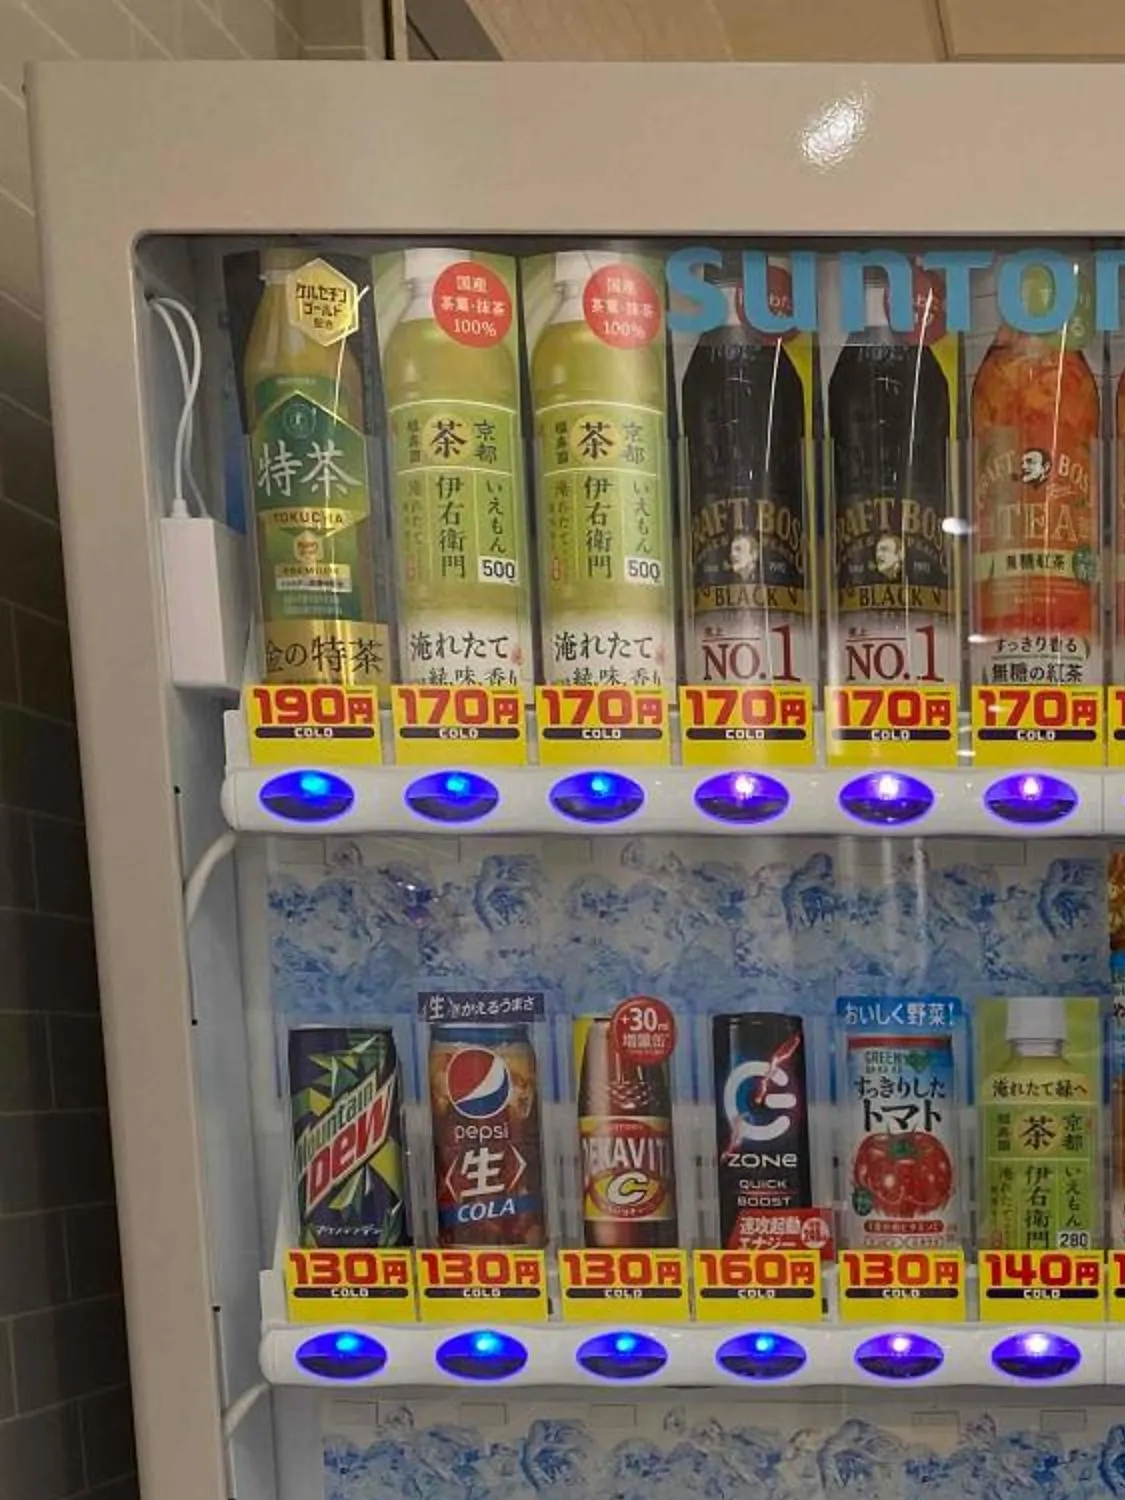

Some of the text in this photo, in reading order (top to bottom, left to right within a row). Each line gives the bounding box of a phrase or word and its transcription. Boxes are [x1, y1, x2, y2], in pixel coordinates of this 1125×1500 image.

[452, 316, 497, 338] 100%
[601, 320, 646, 340] 100%
[430, 420, 467, 459] 茶
[474, 420, 498, 463] 京都
[576, 421, 615, 460] 茶
[622, 421, 646, 463] 京都
[257, 439, 364, 497] 特茶
[435, 475, 466, 579] 伊右衛門
[485, 480, 507, 554] いえもん
[583, 475, 614, 580] 伊右衛門
[632, 481, 652, 554] いえもん
[997, 502, 1079, 542] TEA
[481, 560, 515, 582] 500
[627, 560, 660, 581] 500
[714, 587, 778, 607] BLACK
[859, 587, 922, 606] BLACK
[266, 635, 384, 674] 金の特茶
[410, 631, 510, 662] 淹れたて
[553, 631, 655, 662] 淹れたて
[702, 624, 801, 682] NO.1
[846, 624, 944, 682] NO.1
[996, 637, 1078, 654] すっきり香る
[991, 661, 1084, 682] 無糖の紅茶
[254, 688, 374, 725] 190円
[400, 688, 519, 725] 170円
[545, 688, 664, 725] 170円
[686, 690, 806, 727] 170円
[837, 690, 951, 727] 170円
[978, 690, 1097, 727] 170円
[294, 728, 333, 739] COLD
[439, 728, 479, 739] COLD
[582, 728, 621, 740] COLD
[725, 729, 765, 740] COLD
[870, 729, 910, 740] COLD
[1016, 729, 1056, 740] COLD
[845, 1002, 955, 1026] おいしく野菜!
[854, 1076, 946, 1100] すっきりした
[863, 1099, 943, 1132] トマト
[1021, 1114, 1056, 1150] 茶
[1061, 1113, 1084, 1151] 京都
[454, 1122, 510, 1143] pepsi
[606, 1171, 649, 1206] C
[738, 1179, 788, 1190] QUICK
[1065, 1167, 1083, 1228] いえもん
[456, 1198, 517, 1223] COLA
[737, 1196, 791, 1207] BOOST
[1025, 1165, 1052, 1249] 伊右衛門
[1059, 1232, 1090, 1248] 280
[290, 1252, 407, 1286] 130円
[421, 1252, 541, 1286] 130円
[564, 1252, 682, 1286] 130円
[700, 1253, 816, 1287] 160円
[841, 1253, 959, 1287] 130円
[985, 1253, 1101, 1287] 140円
[331, 1288, 369, 1298] COLD
[463, 1288, 501, 1298] COLD
[604, 1288, 642, 1298] COLD
[737, 1288, 776, 1298] COLD
[882, 1288, 920, 1298] COLD
[1023, 1288, 1061, 1298] COLD
